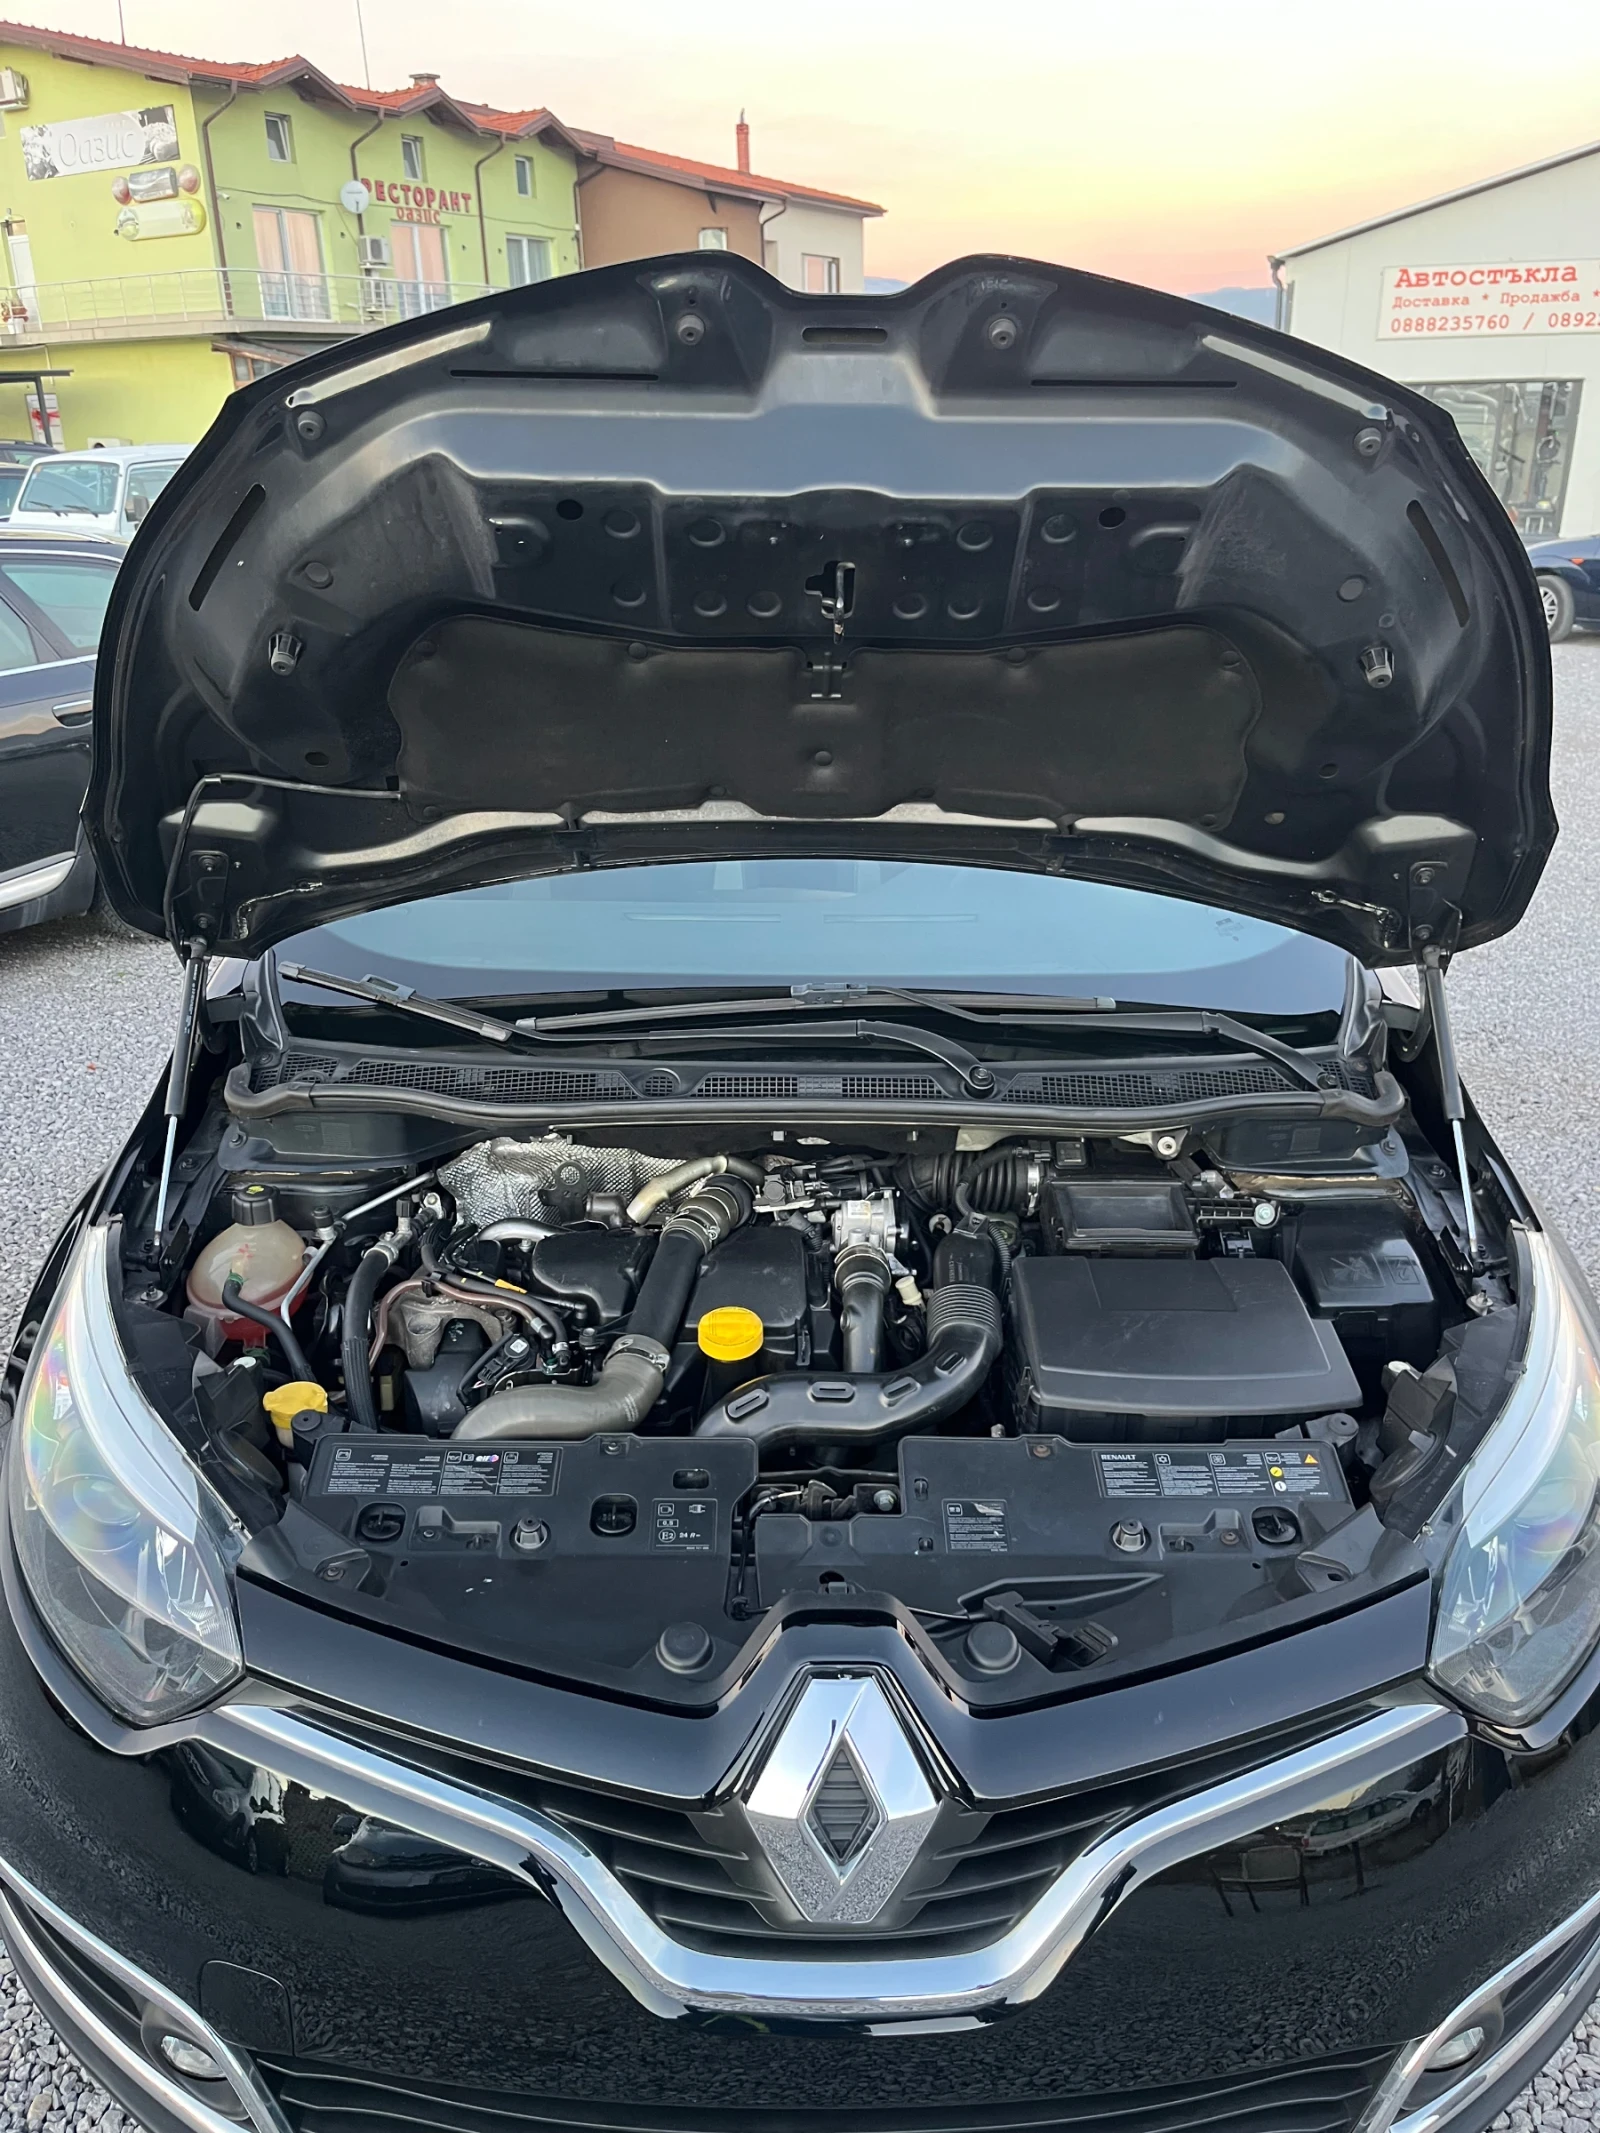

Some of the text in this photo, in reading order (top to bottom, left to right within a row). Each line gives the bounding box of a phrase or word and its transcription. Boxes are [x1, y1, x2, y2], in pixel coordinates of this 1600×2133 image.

[58, 133, 135, 167] Оазис
[1394, 266, 1578, 288] Автостъкла
[1392, 290, 1580, 309] Доставка Продажба
[1391, 314, 1509, 333] 0888235760
[1548, 311, 1600, 328] 0892
